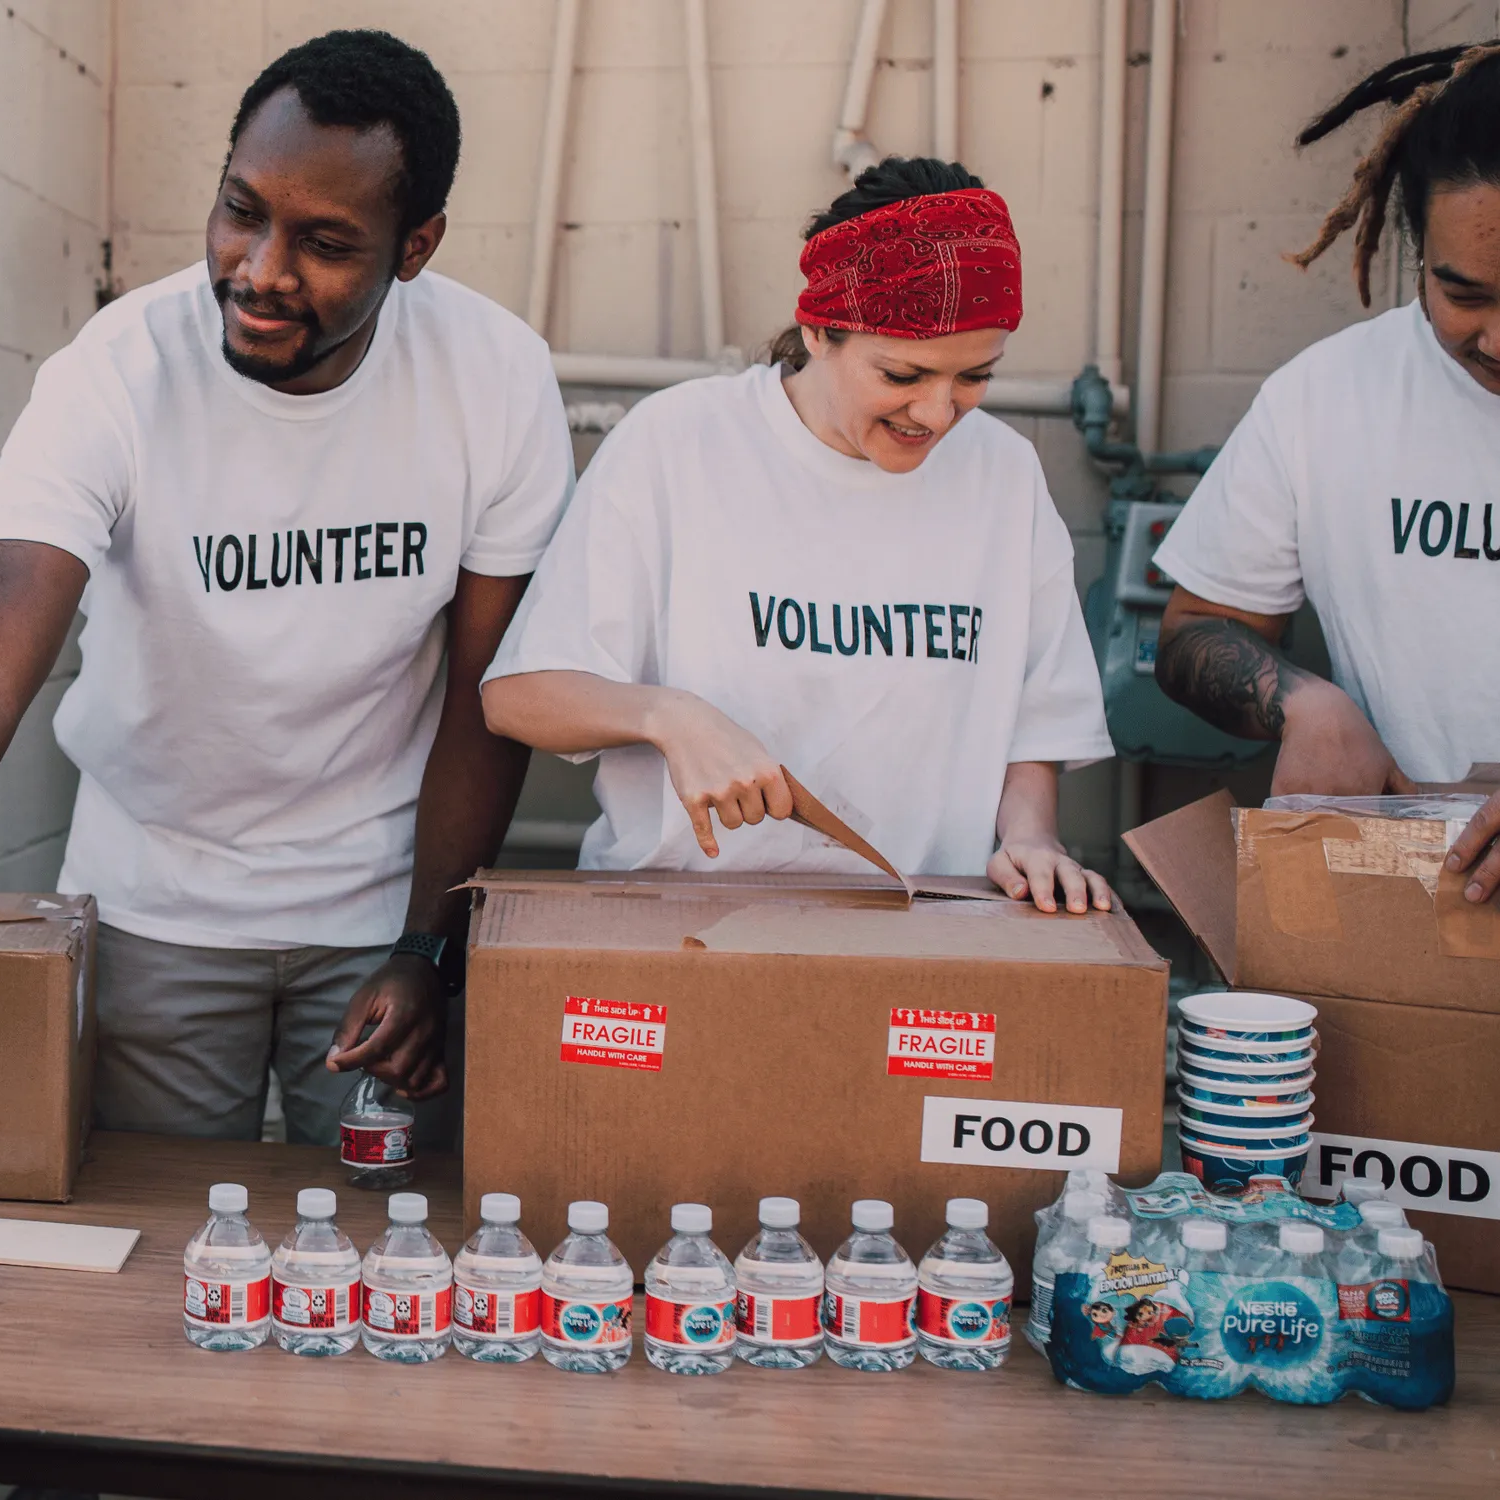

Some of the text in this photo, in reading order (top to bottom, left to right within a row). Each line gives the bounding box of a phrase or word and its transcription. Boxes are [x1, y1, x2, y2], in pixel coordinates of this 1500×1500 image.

[193, 522, 427, 592] VOLUNTEER
[749, 592, 982, 664] VOLUNTEER
[594, 1005, 639, 1016] THIS SIDE UP
[920, 1016, 966, 1026] THIS SIDE UP
[572, 1022, 657, 1047] FRAGILE
[898, 1034, 986, 1056] FRAGILE
[577, 1048, 647, 1062] HANDLE WITH CARE
[903, 1060, 977, 1073] HANDLE WITH CARE
[953, 1113, 1091, 1157] FOOD
[1320, 1145, 1490, 1203] FOOD
[952, 1315, 988, 1328] Pure Life
[1224, 1315, 1319, 1344] Pure Life
